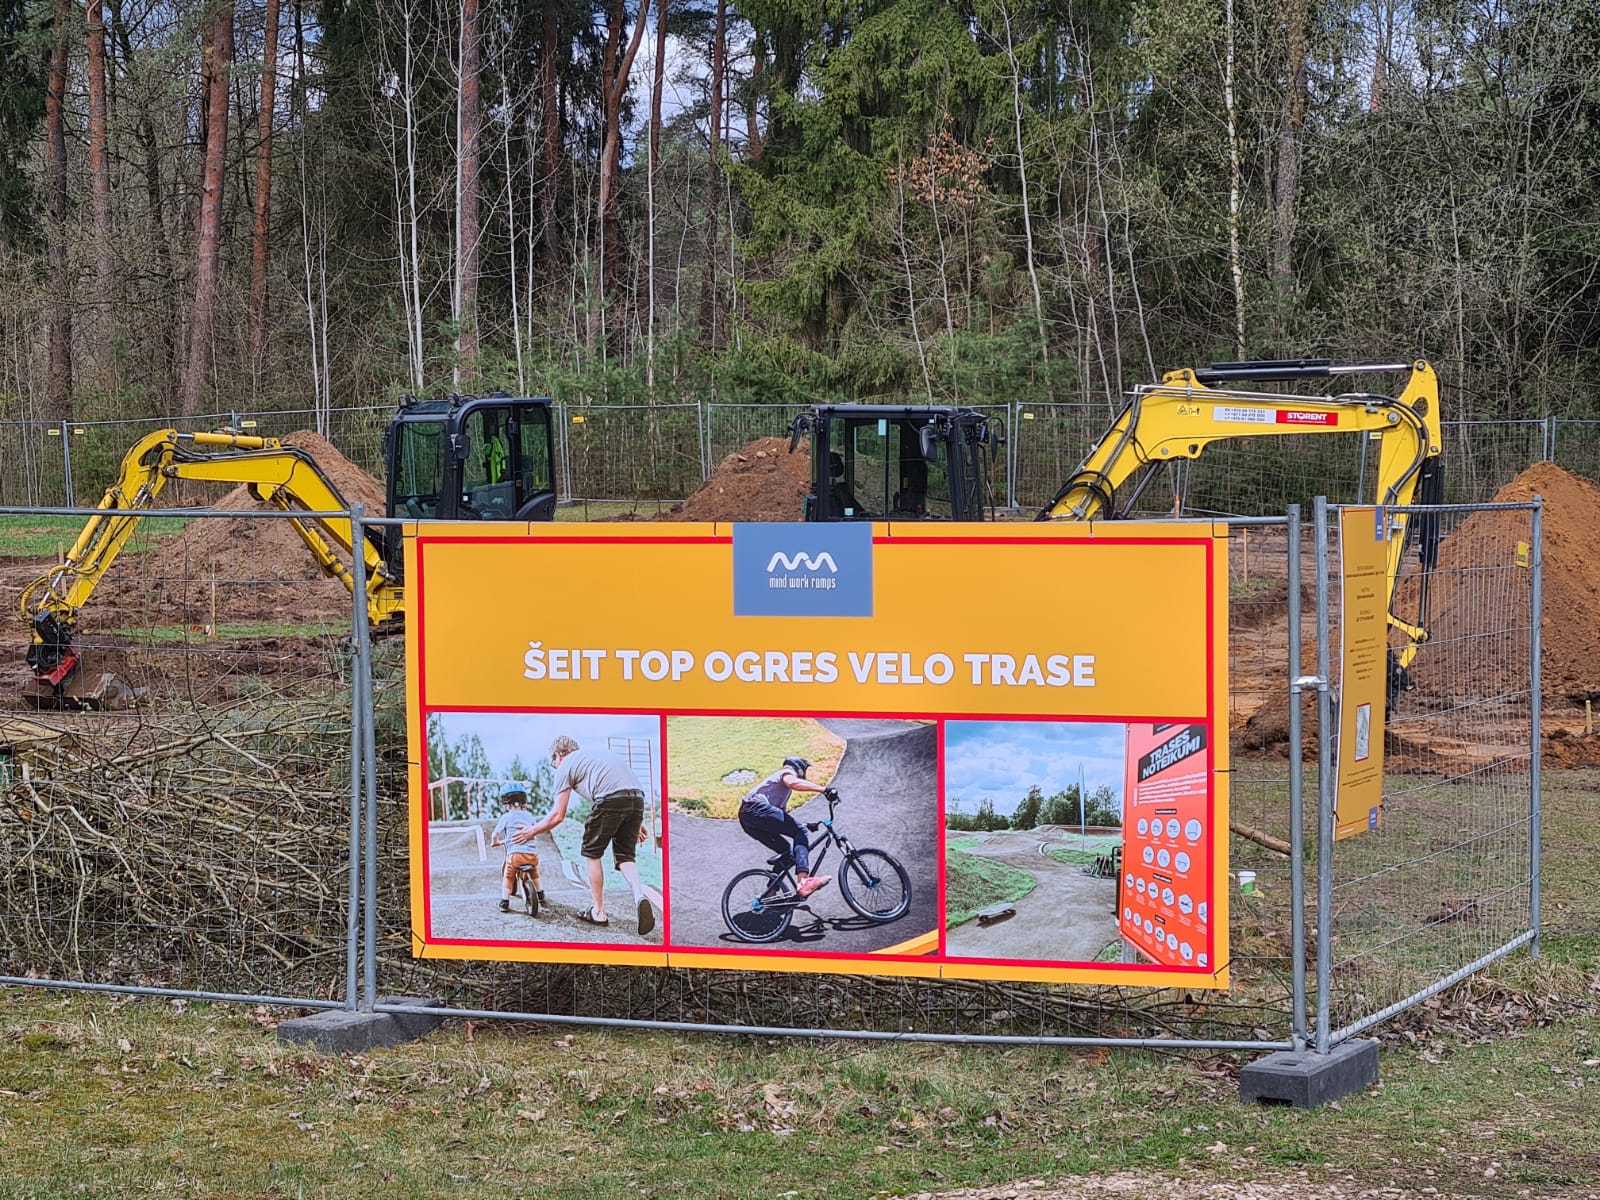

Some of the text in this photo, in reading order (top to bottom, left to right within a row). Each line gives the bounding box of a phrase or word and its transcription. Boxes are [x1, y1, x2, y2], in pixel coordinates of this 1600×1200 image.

[1287, 412, 1328, 420] STORENT
[769, 574, 836, 591] mind work ramps
[523, 640, 1096, 686] ŠEIT TOP OGRES VELO TRASE
[1142, 735, 1201, 779] NOTEIKUMI
[1149, 729, 1191, 764] TRASES
